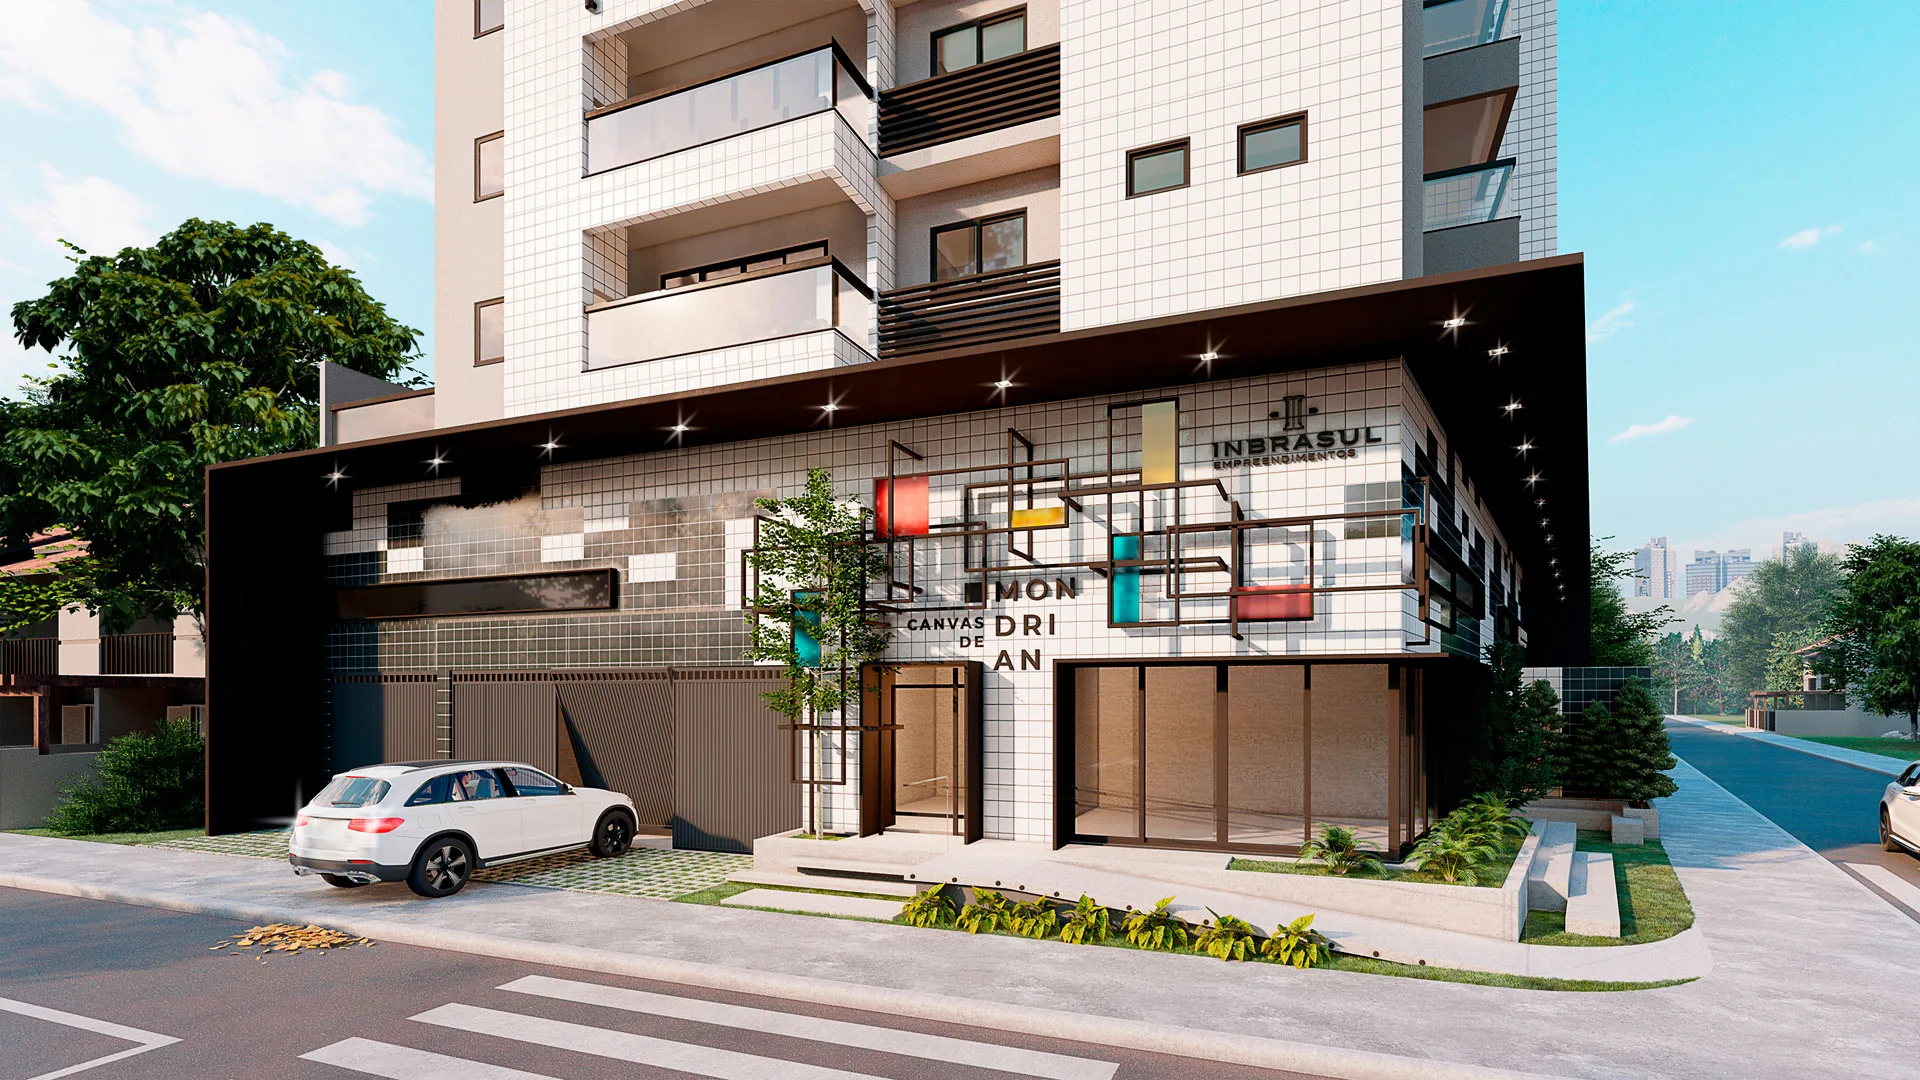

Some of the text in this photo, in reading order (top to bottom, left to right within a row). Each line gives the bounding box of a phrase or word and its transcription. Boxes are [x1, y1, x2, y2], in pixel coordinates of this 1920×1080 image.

[1212, 426, 1382, 458] INBRASUL
[1214, 449, 1356, 469] EMPREENDIMENTOS
[995, 577, 1076, 602] MON
[907, 616, 984, 631] CANVAS
[995, 613, 1055, 637] DRI
[960, 636, 984, 648] DE
[993, 649, 1041, 671] AN
